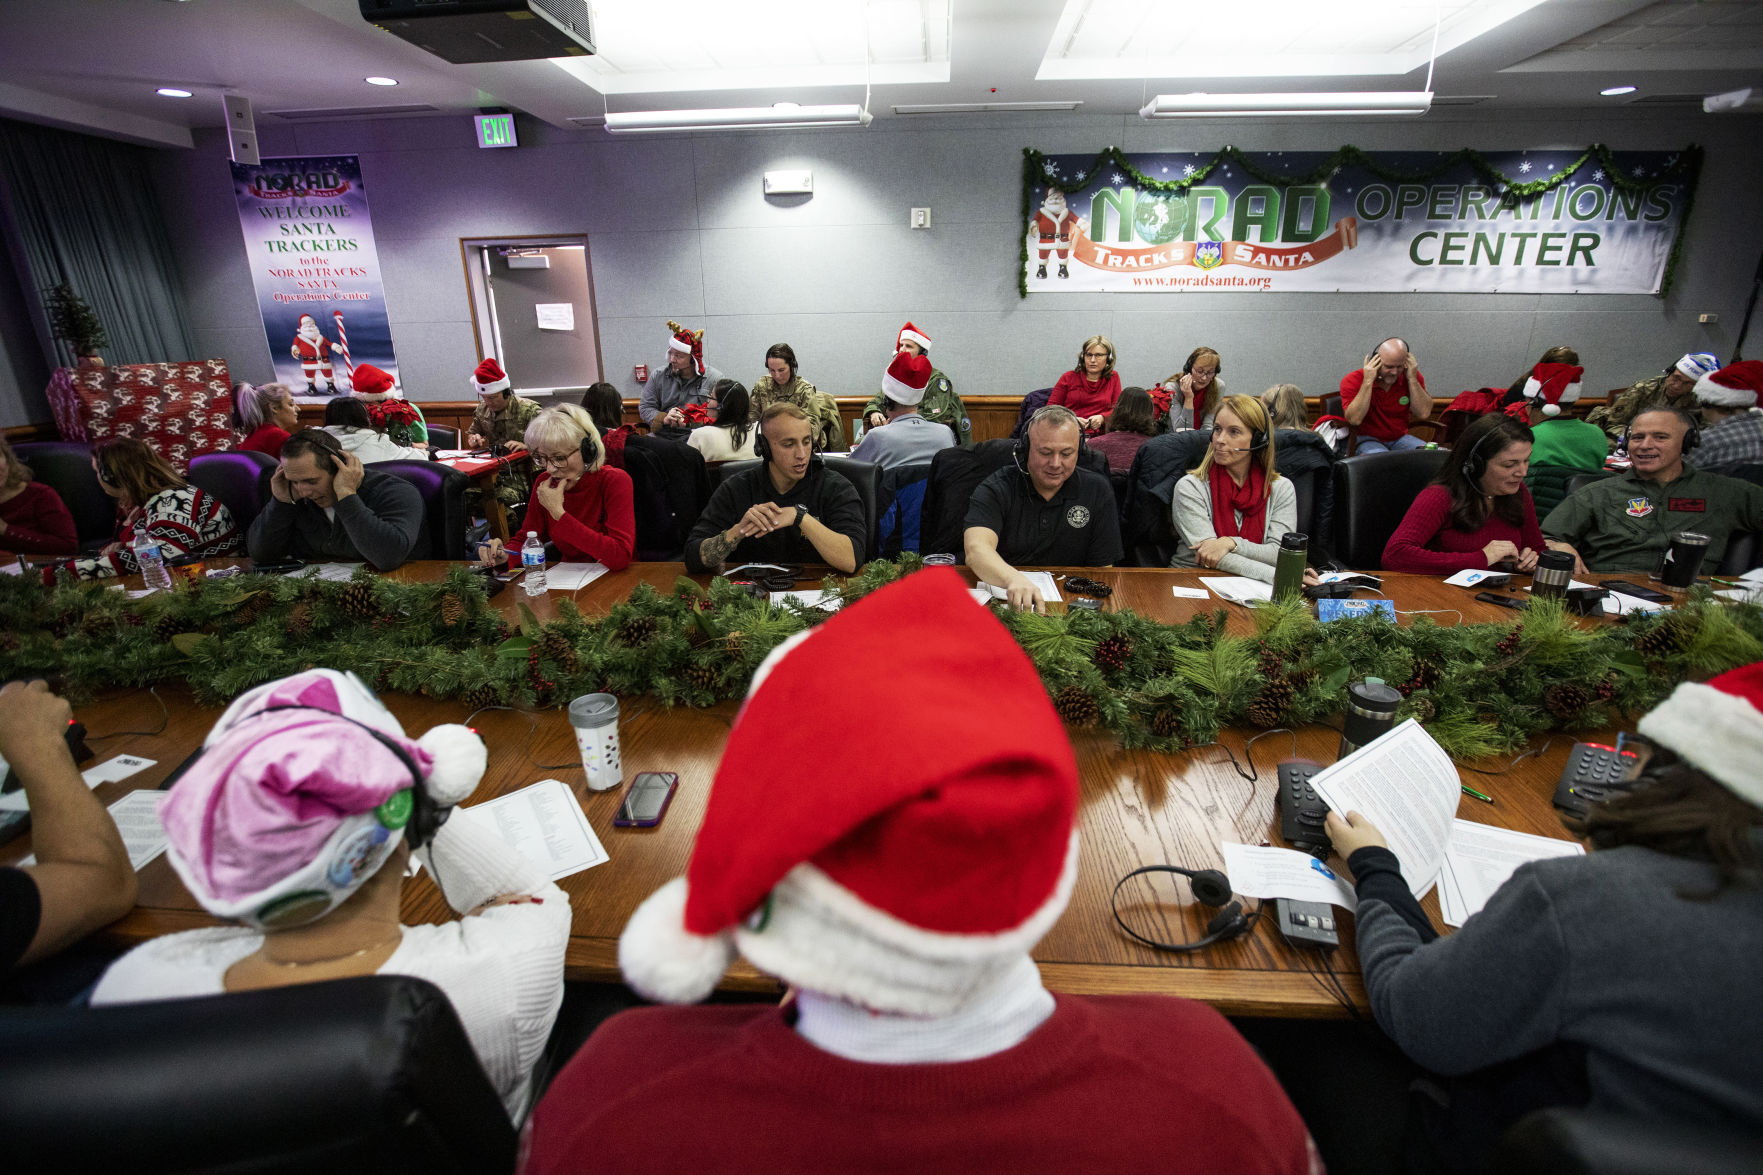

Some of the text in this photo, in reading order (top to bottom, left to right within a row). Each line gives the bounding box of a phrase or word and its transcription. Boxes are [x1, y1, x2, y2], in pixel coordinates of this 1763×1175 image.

[481, 118, 510, 144] EXIT
[255, 173, 340, 191] NORAD
[1354, 183, 1678, 222] OPERATIONS
[257, 204, 351, 219] WELCOME
[1090, 184, 1331, 245] NORAD
[280, 222, 336, 236] SANTA
[264, 239, 359, 253] TRACKERS
[1408, 230, 1602, 268] CENTER
[299, 256, 329, 265] to the
[1093, 244, 1315, 268] TRACKS SANTA
[268, 267, 367, 278] NORAD TRACKS
[297, 280, 338, 289] SANTA
[1132, 274, 1272, 290] www.noradsanta.org
[273, 291, 370, 304] Operations Center
